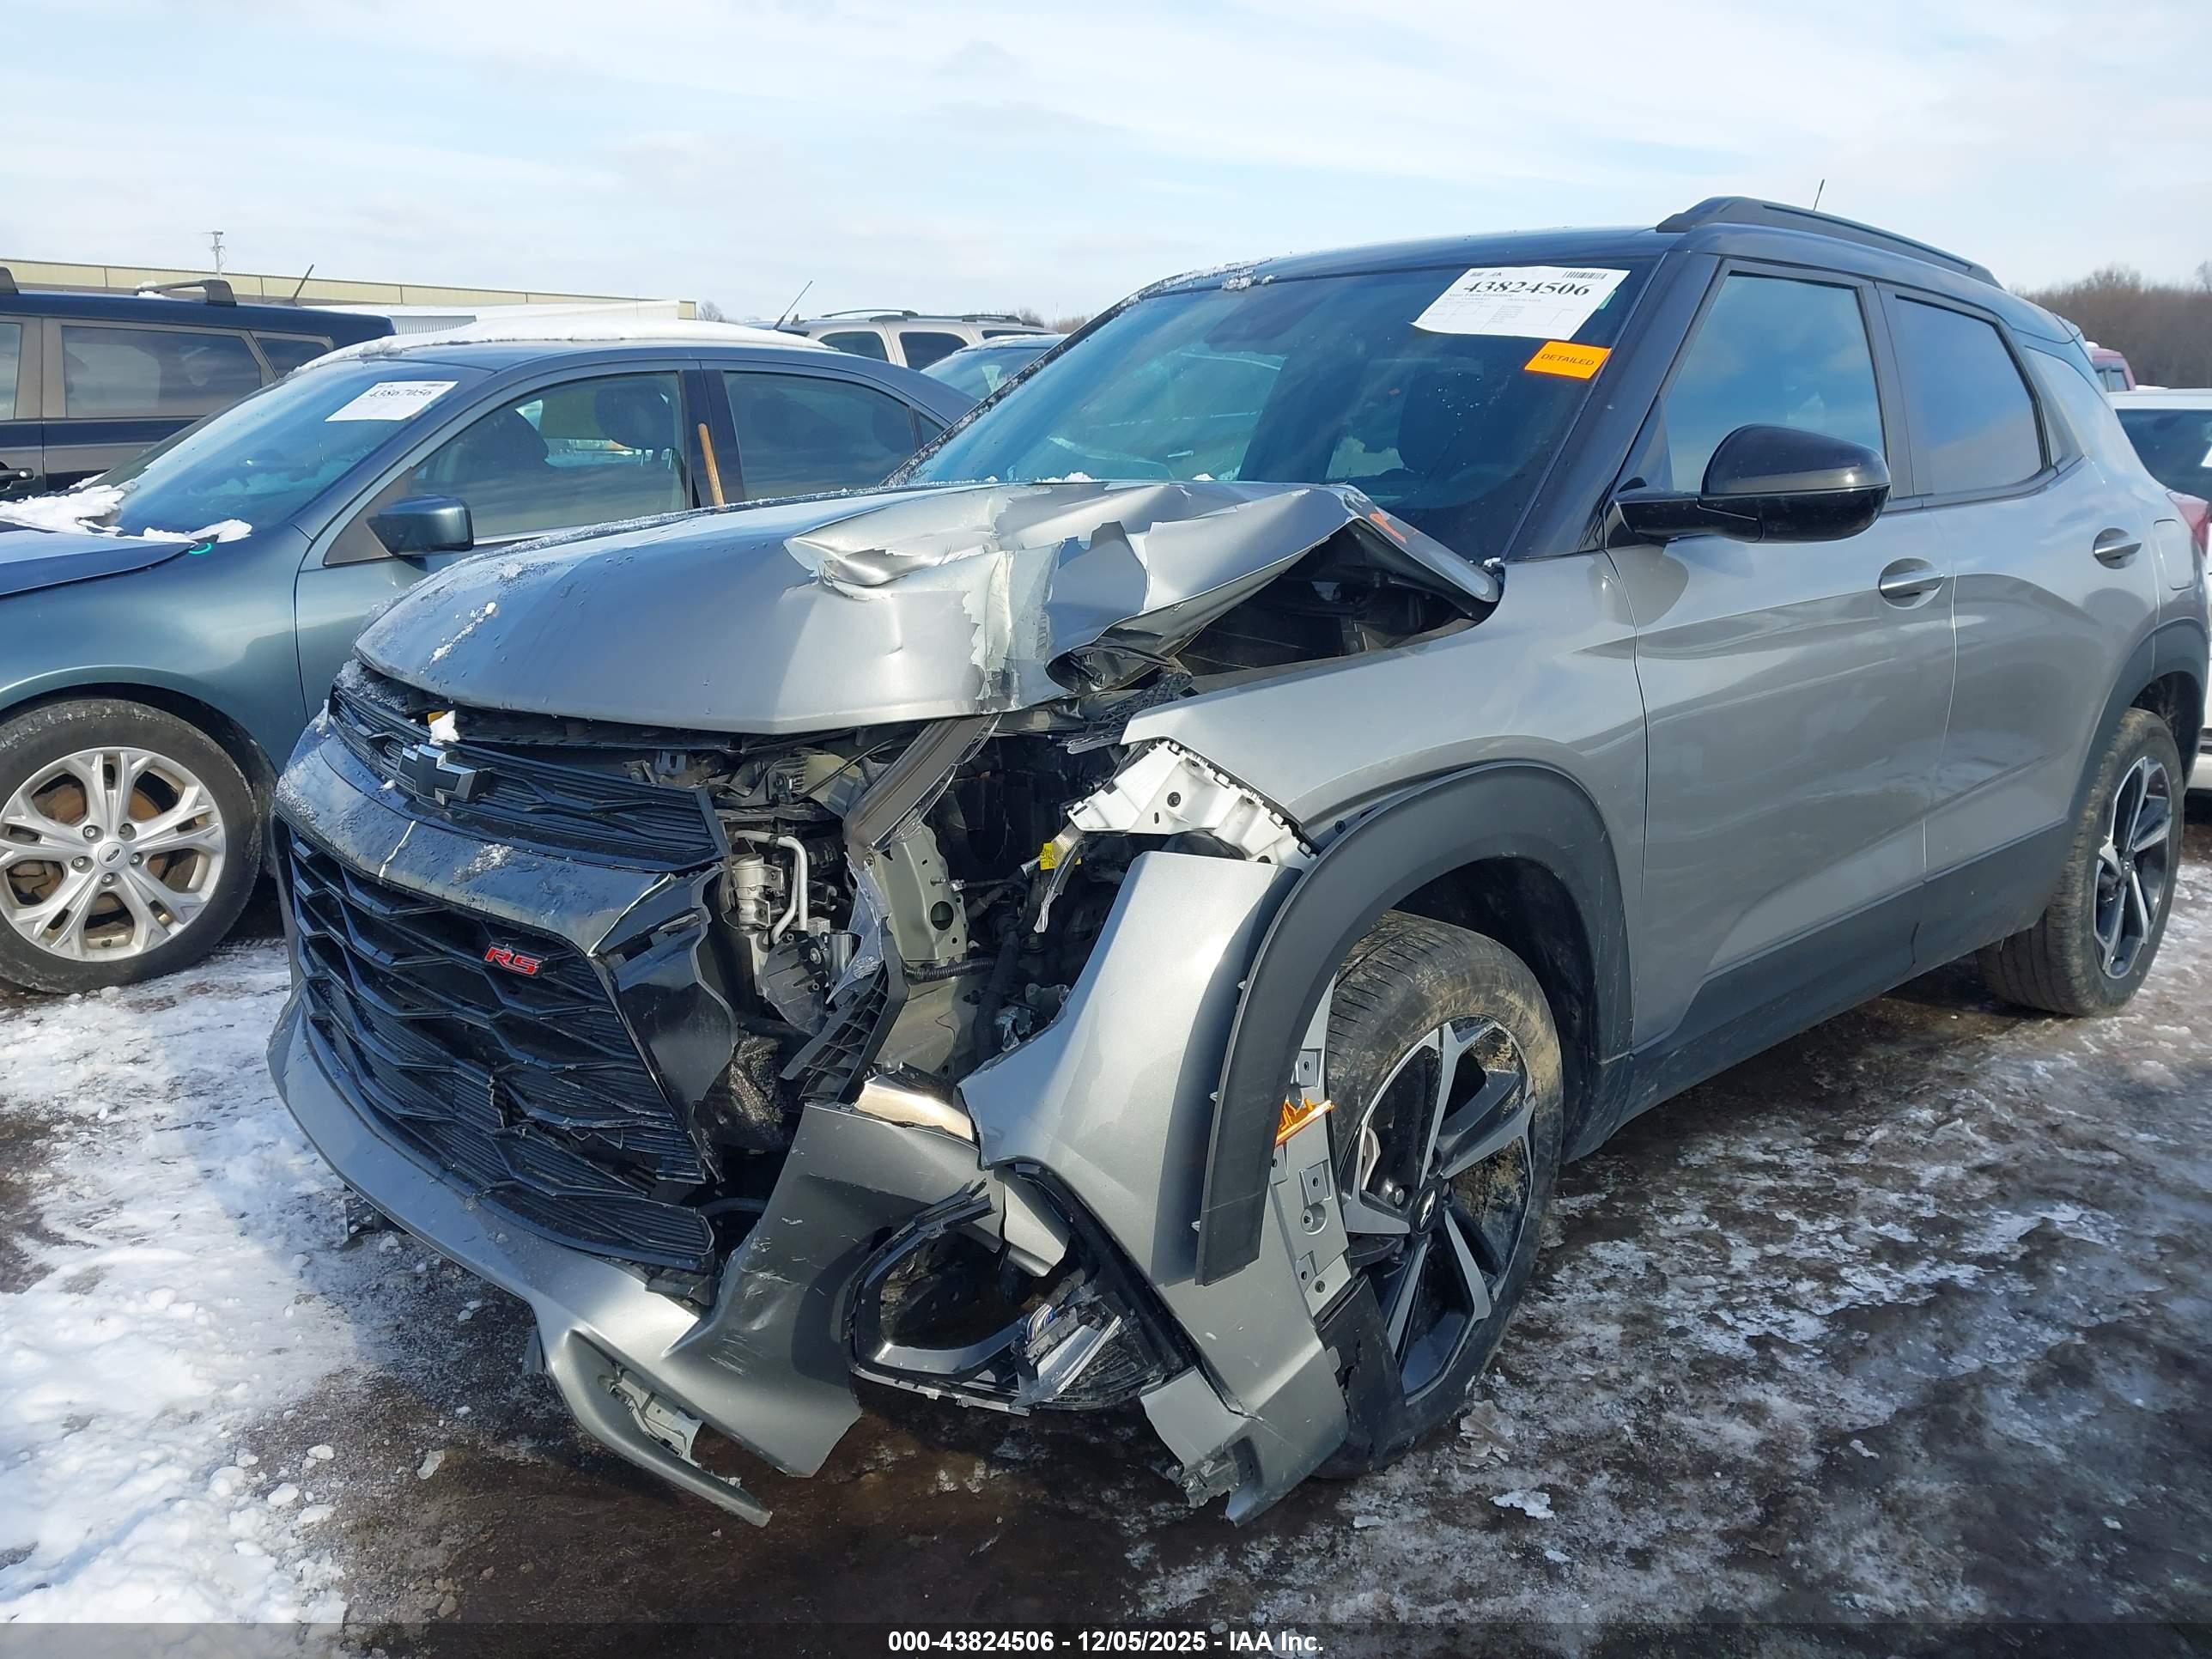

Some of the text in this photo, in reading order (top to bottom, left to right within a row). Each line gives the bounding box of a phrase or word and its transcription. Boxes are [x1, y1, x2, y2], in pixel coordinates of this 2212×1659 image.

[1463, 281, 1594, 296] 43824506
[1540, 353, 1595, 366] DETAILED
[485, 946, 541, 975] RS
